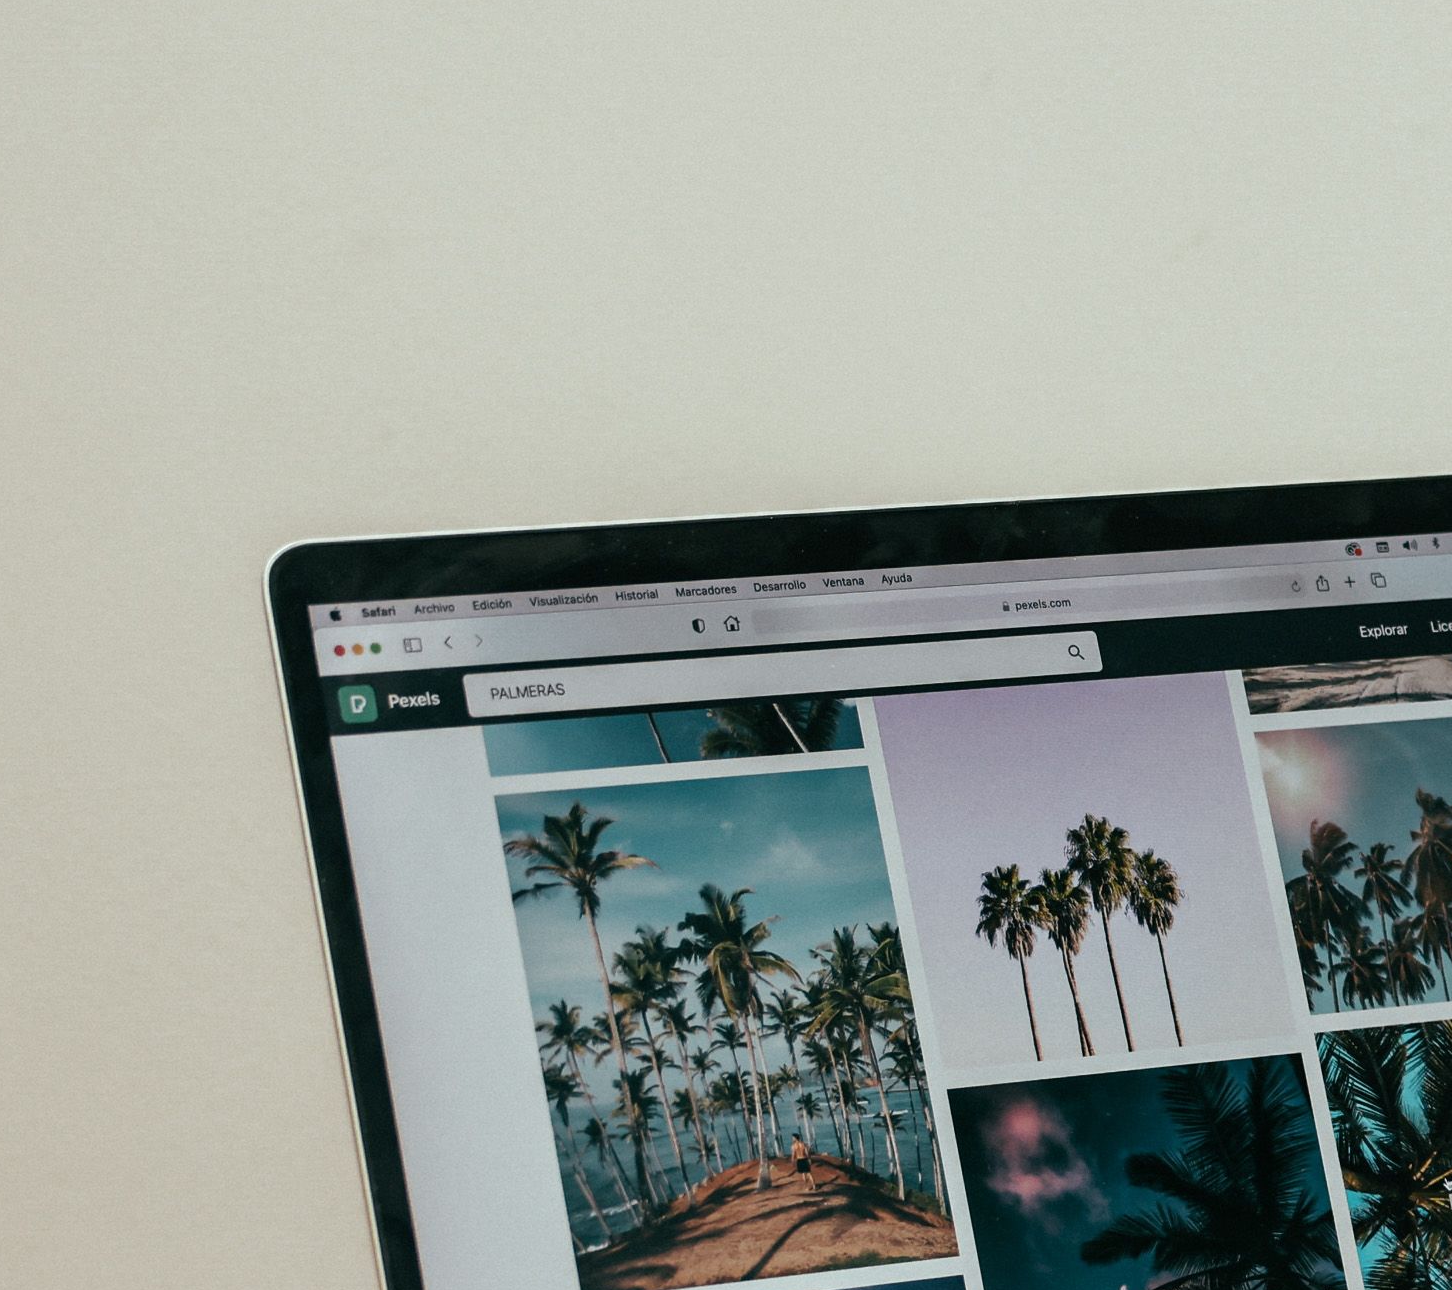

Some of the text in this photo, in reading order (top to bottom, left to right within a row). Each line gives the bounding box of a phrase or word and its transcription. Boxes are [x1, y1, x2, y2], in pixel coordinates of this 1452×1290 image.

[361, 573, 913, 618] Safari Archivo Edición Visualización Historial Marcadores Desarrollo Ventana Ayuda
[1014, 597, 1072, 611] pexels.com
[1359, 623, 1409, 639] Explorar
[388, 691, 440, 709] Pexels
[490, 683, 566, 700] PALMERAS
